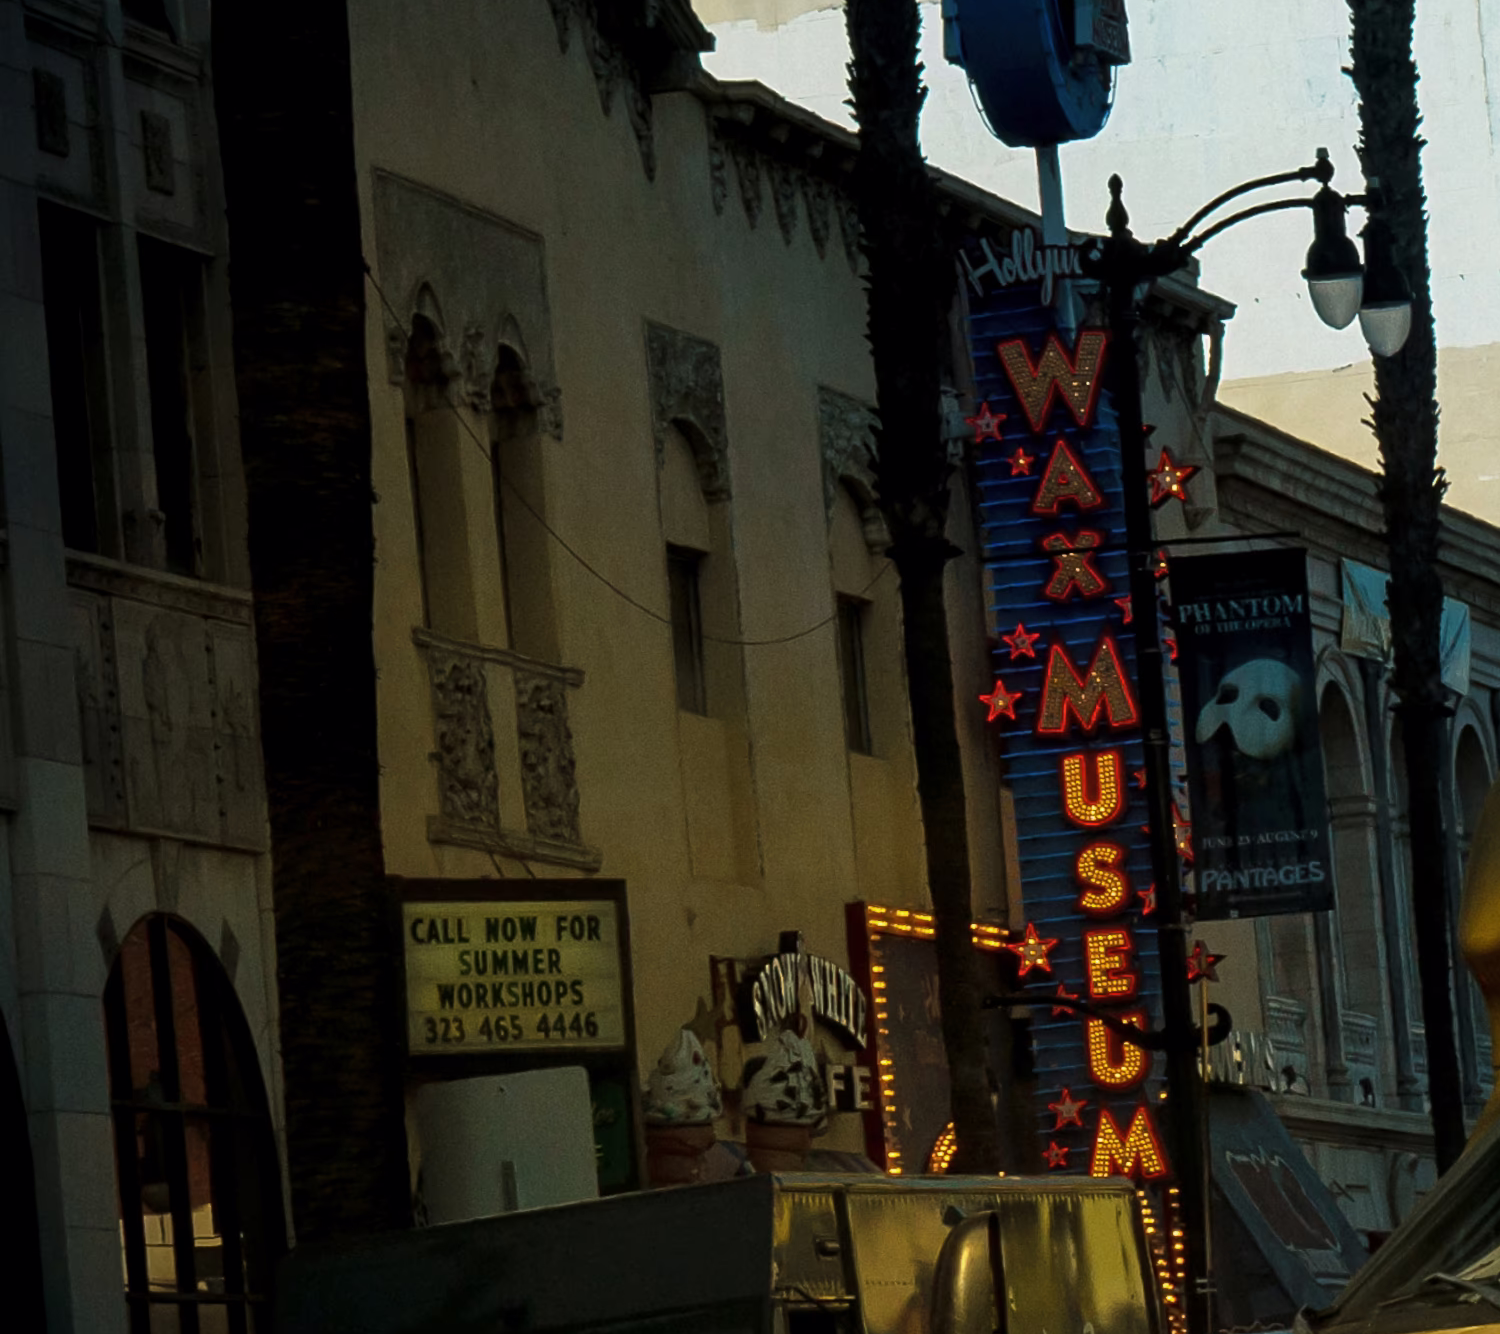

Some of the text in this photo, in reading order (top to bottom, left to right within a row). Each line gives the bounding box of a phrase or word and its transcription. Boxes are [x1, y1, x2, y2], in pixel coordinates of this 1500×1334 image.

[998, 331, 1107, 602] WAX
[1178, 593, 1304, 625] PHANTOM
[1202, 861, 1325, 893] PANTAGES
[1037, 636, 1166, 1179] MUSEUM
[411, 915, 600, 943] CALL NOW FOR
[459, 948, 561, 975] SUMMER
[438, 980, 584, 1009] WORKSHOPS
[809, 955, 868, 1050] WHITE
[426, 1012, 598, 1043] 323 465 4446
